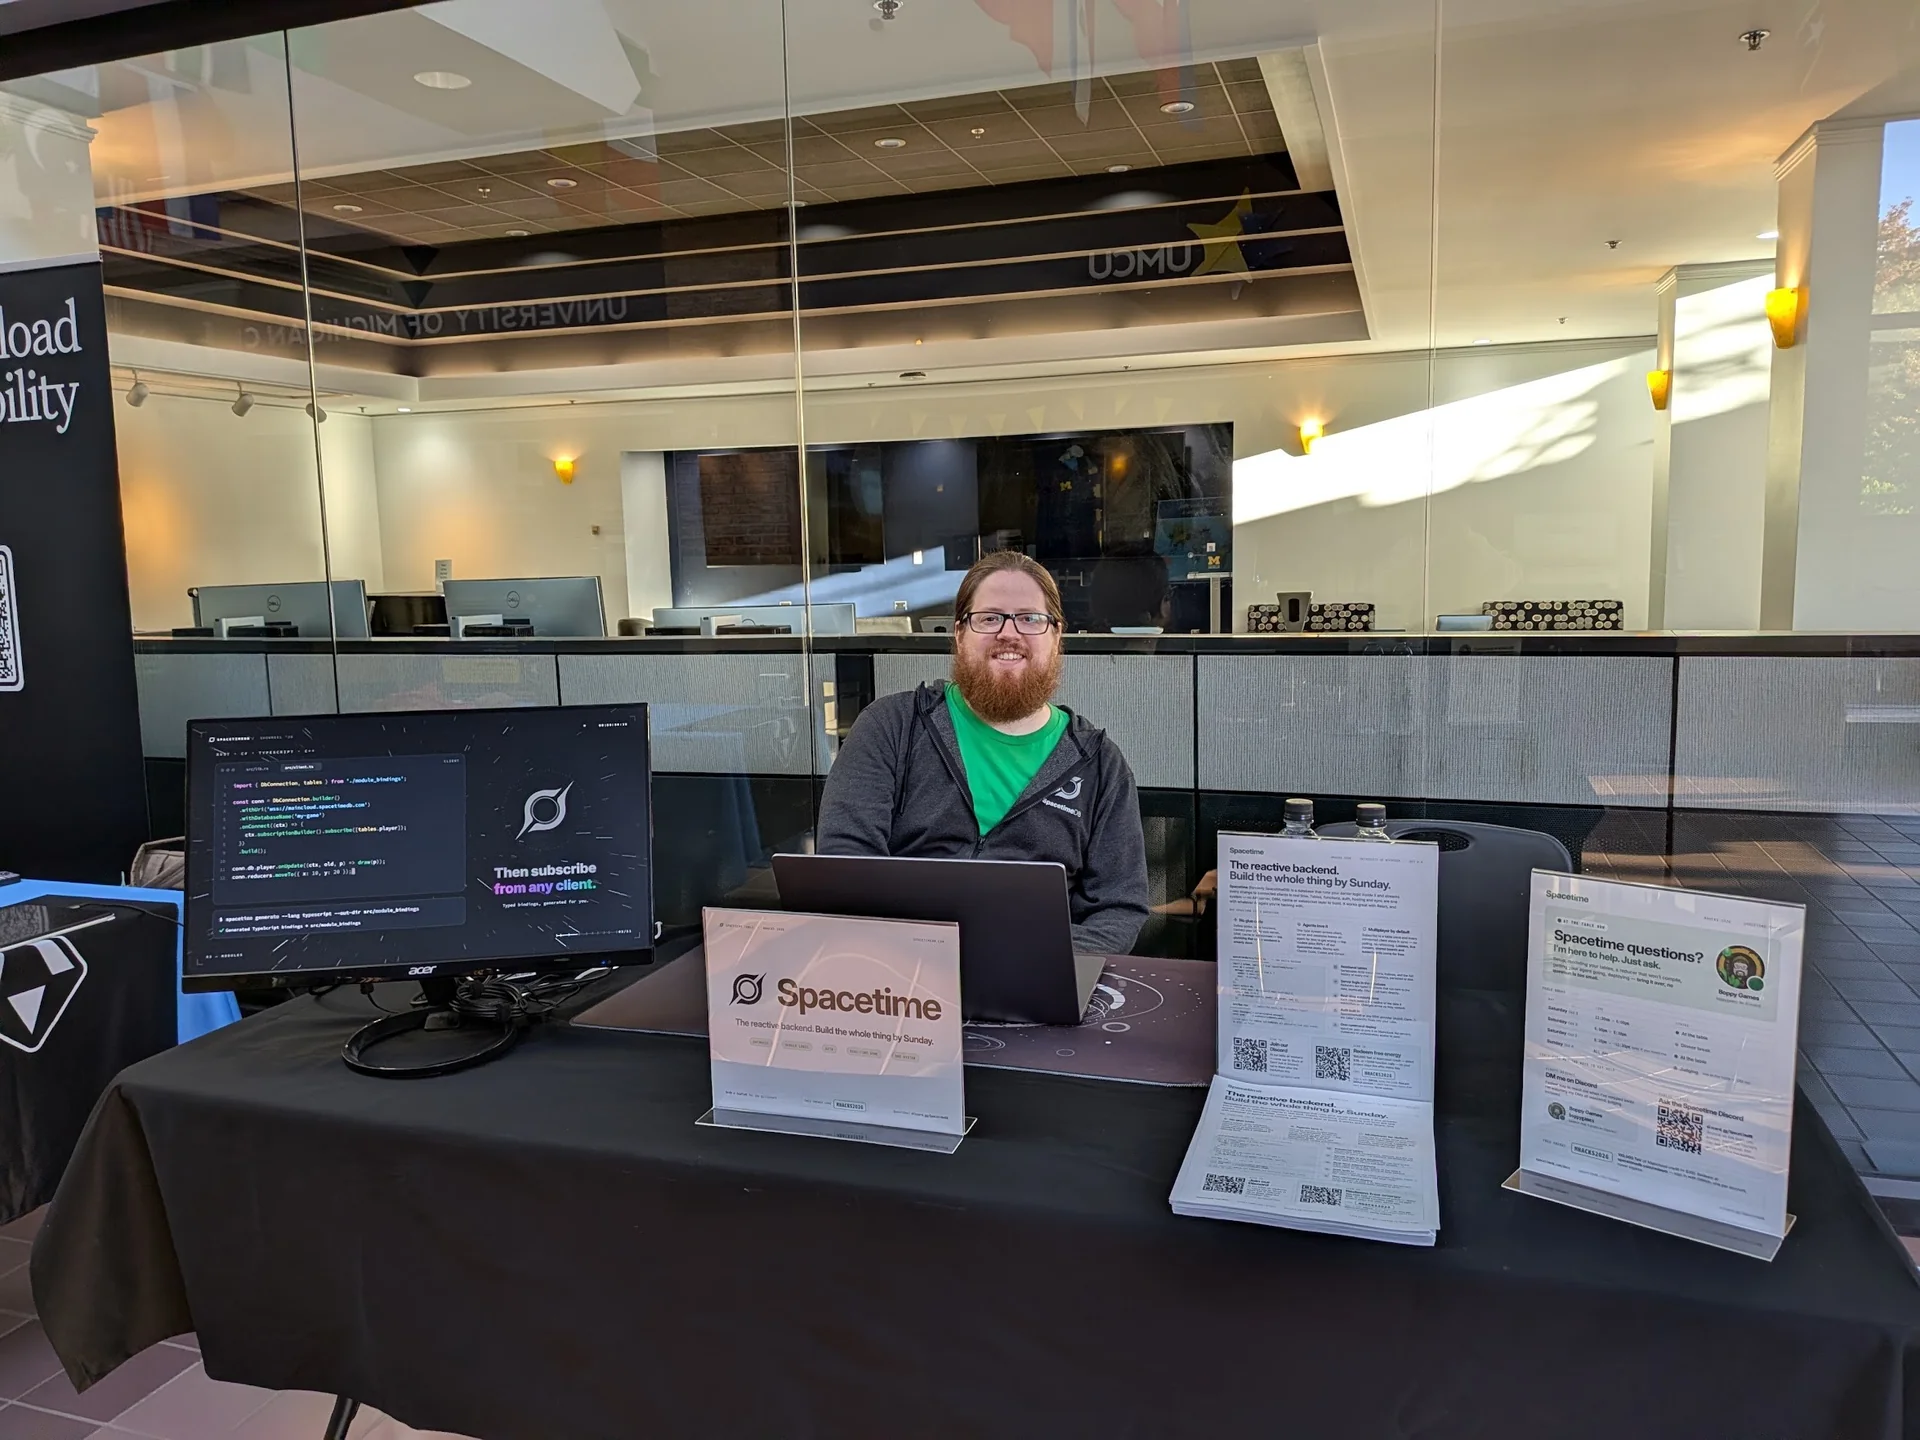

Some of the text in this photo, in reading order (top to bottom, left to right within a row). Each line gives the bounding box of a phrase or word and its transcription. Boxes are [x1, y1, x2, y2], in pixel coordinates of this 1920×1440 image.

[0, 368, 80, 434] ility
[1229, 846, 1264, 856] Spacetime
[494, 862, 597, 879] Then subscribe
[1229, 860, 1339, 875] The reactive backend.
[494, 879, 596, 895] from any client.
[1229, 871, 1391, 891] Build the whole thing by Sunday.
[1546, 889, 1589, 903] Spacetime
[1554, 929, 1704, 964] Spacetime questions?
[1553, 944, 1661, 970] I'm here to help. Just ask.
[408, 964, 437, 975] acer
[777, 978, 942, 1021] Spacetime
[1719, 989, 1760, 1001] Boppy Games
[1548, 1005, 1568, 1013] Saturday
[1547, 1016, 1567, 1025] Saturday
[735, 1018, 934, 1046] The reactive backend. Build the whole thing by Sunday.
[1547, 1027, 1567, 1036] Saturday
[1546, 1038, 1563, 1047] Sunday
[1545, 1072, 1556, 1080] DM
[1575, 1079, 1598, 1089] Discord
[1224, 1095, 1389, 1119] Build the whole thing by Sunday.
[1226, 1090, 1336, 1108] The reactive backend.
[1659, 1098, 1744, 1122] Ask the Spacetime Discord
